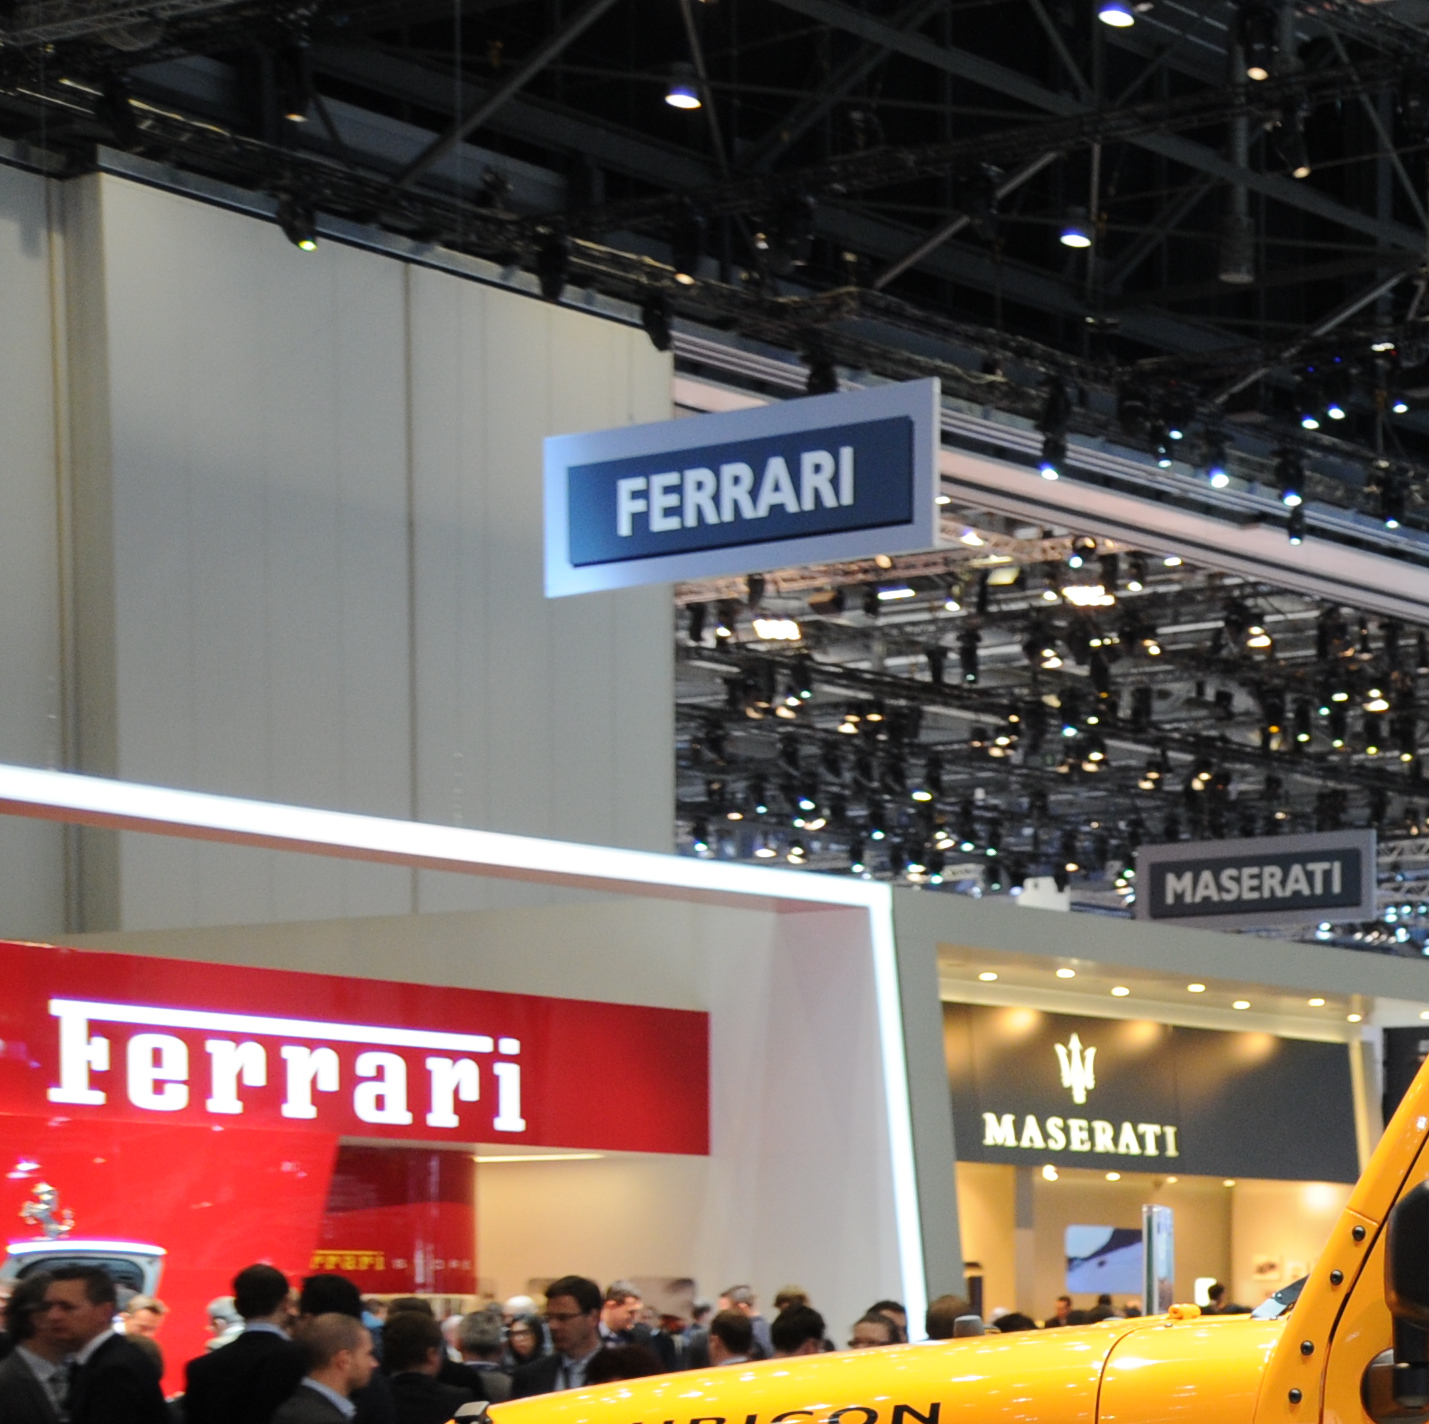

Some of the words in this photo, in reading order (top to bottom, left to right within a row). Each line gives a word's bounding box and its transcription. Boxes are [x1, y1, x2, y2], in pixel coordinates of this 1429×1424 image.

[616, 446, 854, 538] FERRARI
[1164, 861, 1342, 905] MASERATI
[47, 997, 526, 1132] Ferrari
[982, 1112, 1180, 1158] MASERATI
[310, 1249, 386, 1271] rrari
